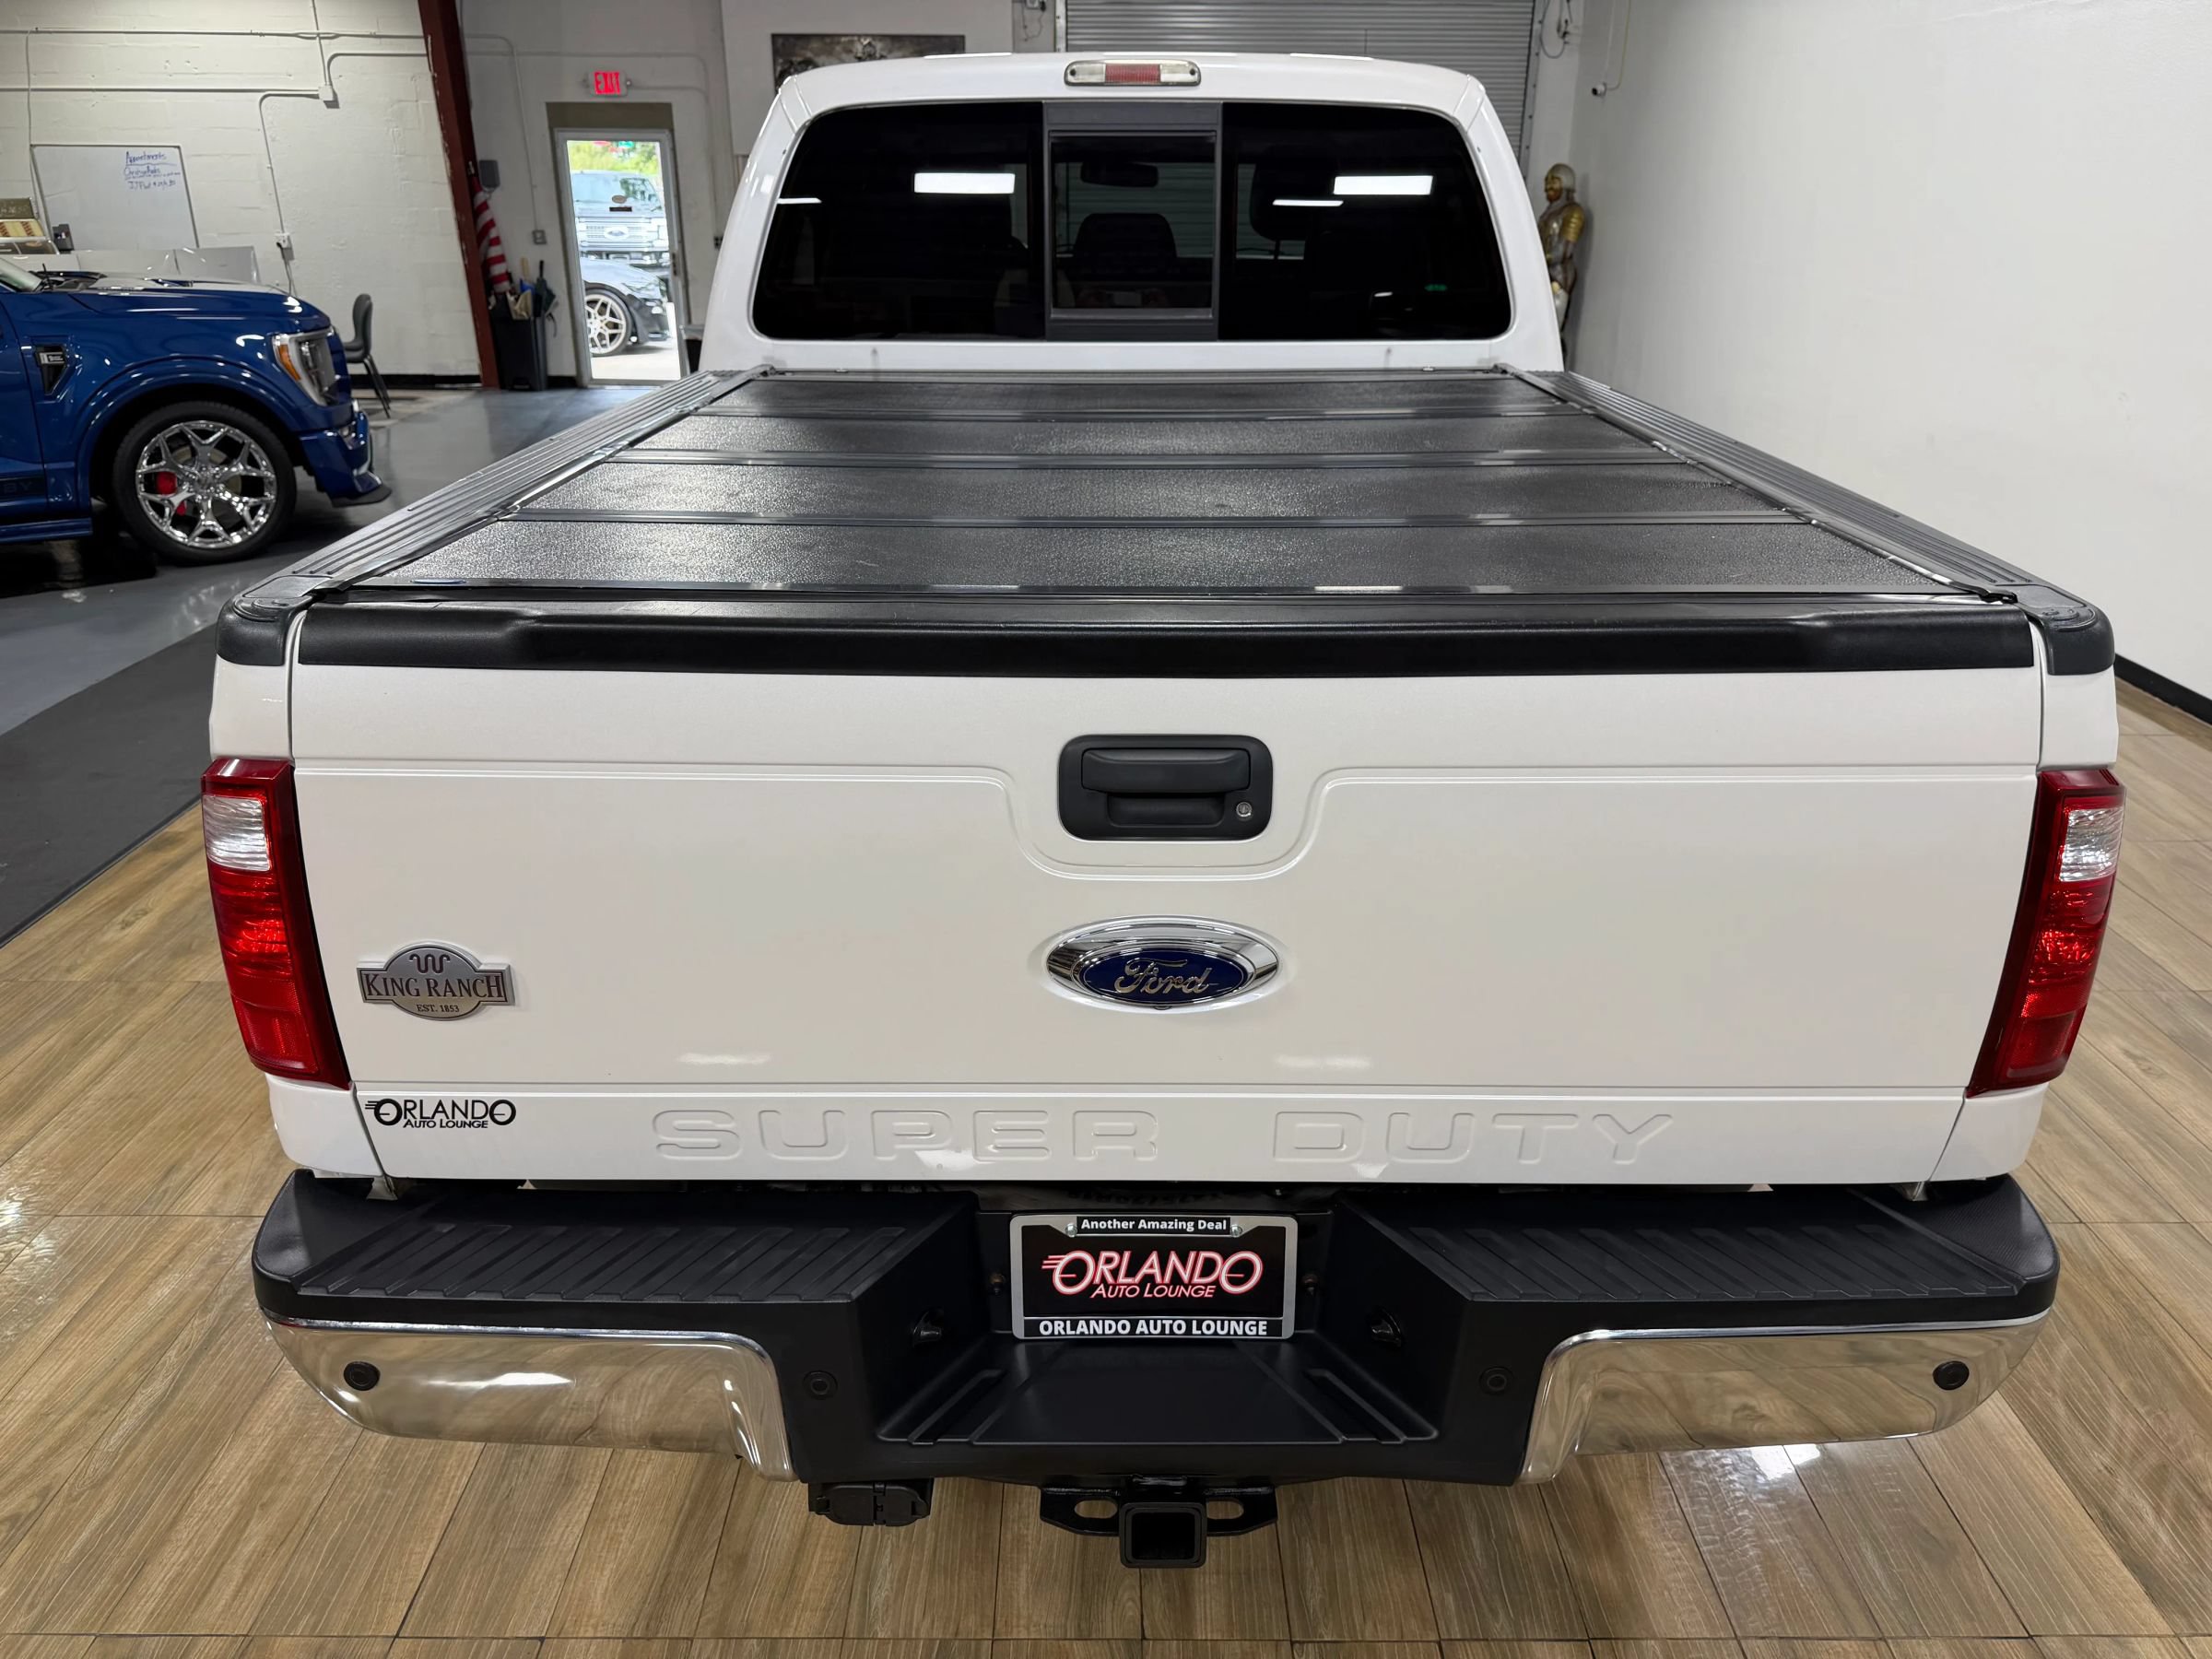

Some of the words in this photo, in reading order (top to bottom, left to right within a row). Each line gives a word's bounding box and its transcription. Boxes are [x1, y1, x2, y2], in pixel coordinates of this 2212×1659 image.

[594, 71, 620, 95] EXIT
[362, 973, 420, 997] KING
[426, 975, 505, 998] RANCH
[1113, 958, 1213, 994] Ford
[416, 1004, 438, 1013] EST.
[441, 1005, 460, 1013] 1853
[367, 1098, 516, 1125] ORLANDO
[403, 1120, 437, 1128] AUTO
[440, 1120, 488, 1128] LOUNGE
[653, 1110, 1159, 1162] SUPER
[1273, 1112, 1674, 1165] DUTY
[1081, 1218, 1135, 1230] Another
[1138, 1218, 1194, 1231] Amazing
[1198, 1219, 1227, 1230] Deal
[1043, 1250, 1263, 1295] ORLANDO
[1089, 1284, 1140, 1298] AUTO
[1143, 1284, 1217, 1299] LOUNGE
[1039, 1320, 1131, 1335] ORLANDO
[1135, 1320, 1187, 1335] AUTO
[1192, 1321, 1267, 1335] LOUNGE
